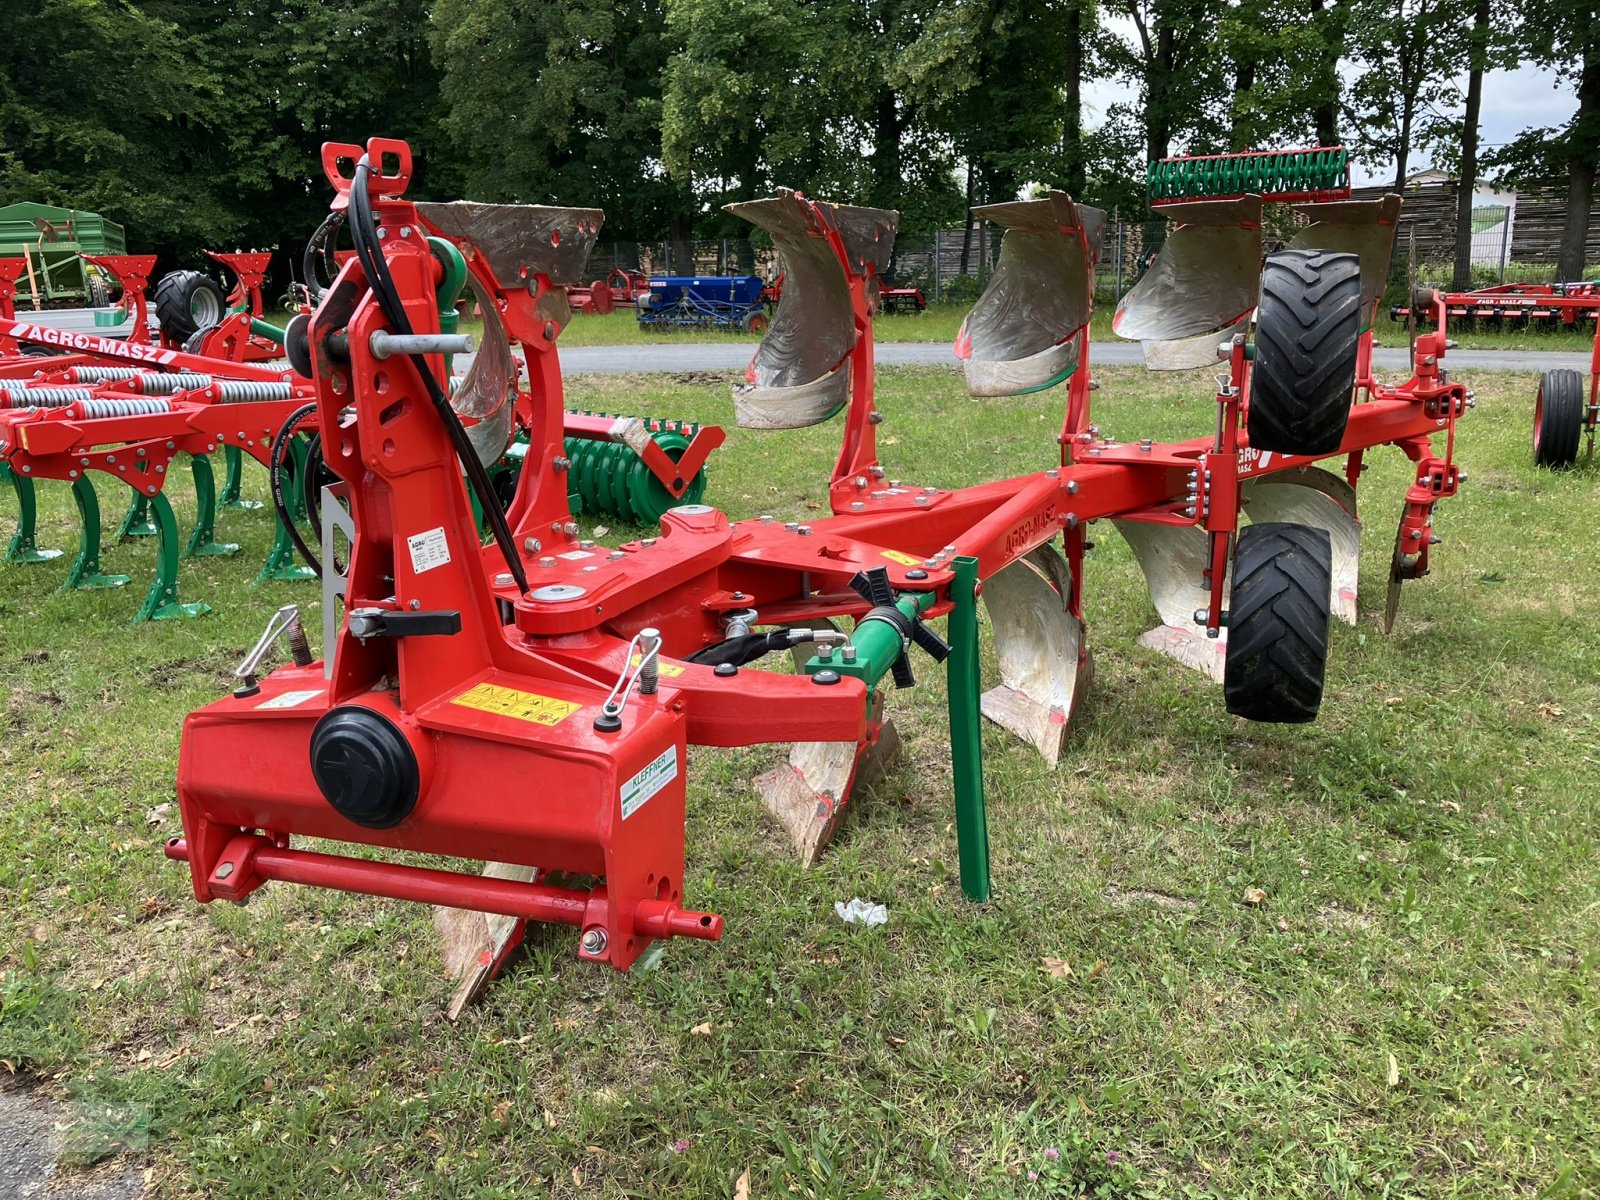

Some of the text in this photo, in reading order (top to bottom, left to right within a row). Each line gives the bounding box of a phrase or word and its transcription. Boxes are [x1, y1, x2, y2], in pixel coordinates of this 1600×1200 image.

[28, 326, 157, 362] AGRO-MASZ
[1238, 447, 1260, 464] GRO
[632, 754, 666, 789] KLEFFNER
